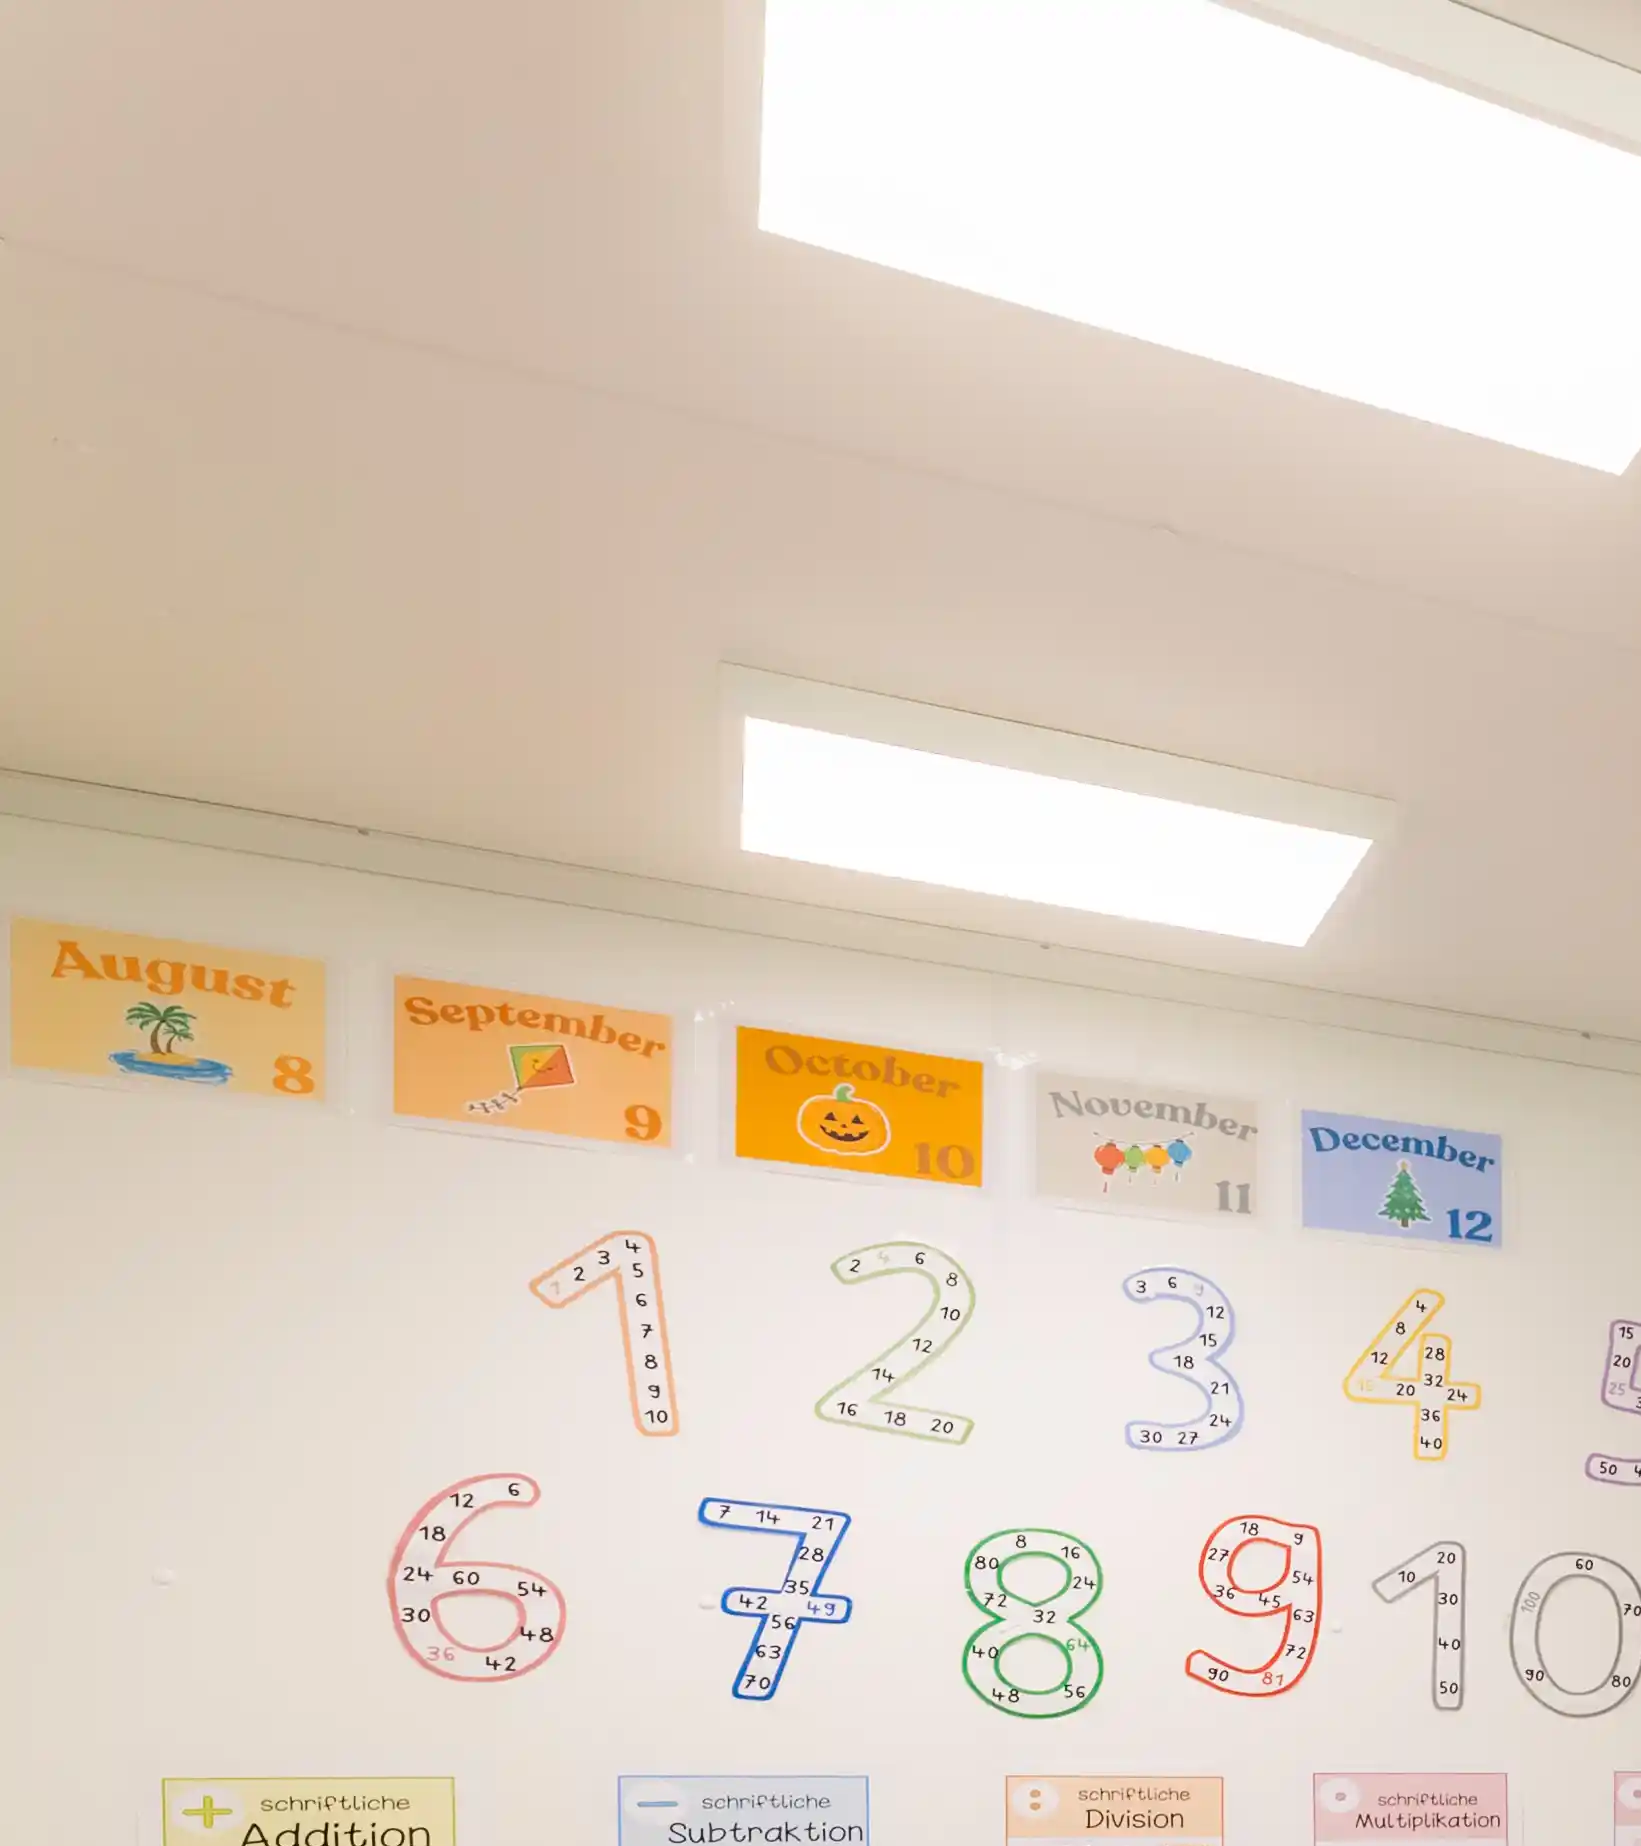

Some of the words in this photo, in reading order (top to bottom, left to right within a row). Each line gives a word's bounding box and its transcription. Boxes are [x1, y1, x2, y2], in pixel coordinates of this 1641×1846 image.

[51, 941, 296, 1008] August
[403, 997, 667, 1061] September
[273, 1055, 314, 1094] 8
[765, 1046, 960, 1098] October
[625, 1104, 662, 1141] 9
[1050, 1090, 1258, 1143] November
[1309, 1126, 1496, 1174] December
[914, 1144, 974, 1179] 10
[1215, 1182, 1252, 1214] 11
[1447, 1210, 1493, 1243] 12
[598, 1250, 610, 1265] 3
[915, 1252, 924, 1266] 6
[1207, 1306, 1224, 1320] 12
[529, 1230, 679, 1436] 1
[1619, 1326, 1634, 1340] 15
[815, 1241, 976, 1444] 2
[912, 1338, 932, 1353] 12
[1123, 1267, 1244, 1451] 3
[1425, 1346, 1445, 1361] 28
[1343, 1288, 1481, 1460] 4
[645, 1410, 668, 1424] 10
[1599, 1462, 1617, 1476] 50
[508, 1483, 520, 1496] 6
[756, 1510, 780, 1525] 14
[1240, 1522, 1259, 1536] 18
[975, 1556, 999, 1571] 80
[1437, 1551, 1455, 1565] 20
[387, 1473, 566, 1682] 6
[698, 1498, 852, 1700] 7
[1186, 1515, 1322, 1697] 9
[963, 1528, 1103, 1718] 8
[1033, 1610, 1056, 1625] 32
[486, 1657, 516, 1672] 42
[744, 1676, 771, 1690] 70
[260, 1795, 411, 1811] schriftliche
[702, 1796, 831, 1810] schriftliche
[1078, 1788, 1190, 1801] schriftliche
[1378, 1793, 1478, 1806] schriftliche
[1086, 1809, 1184, 1829] Division
[1355, 1813, 1500, 1831] Multiplikation
[668, 1822, 863, 1844] Subtraktion
